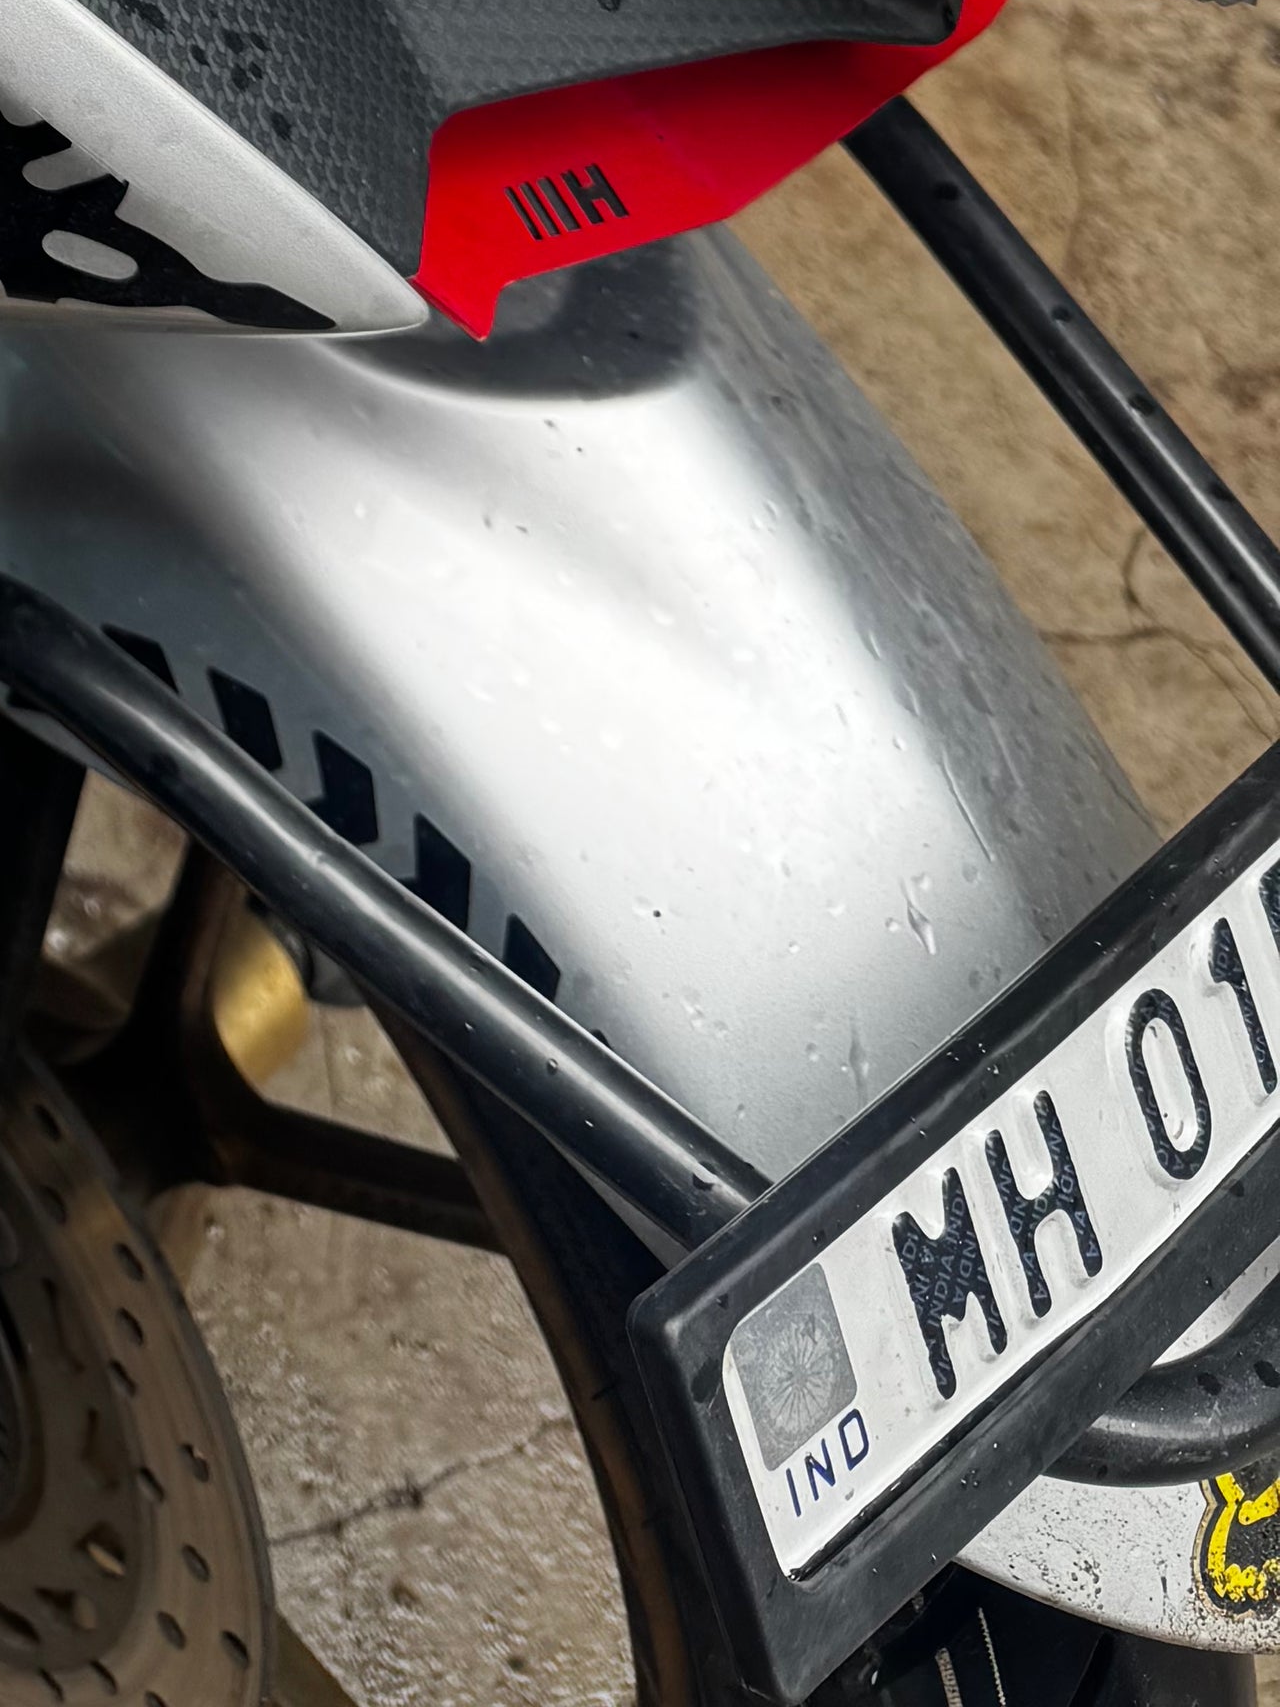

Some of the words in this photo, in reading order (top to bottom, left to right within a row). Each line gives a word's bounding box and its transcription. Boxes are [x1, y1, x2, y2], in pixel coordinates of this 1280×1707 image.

[890, 1089, 1103, 1400] MH
[1124, 915, 1278, 1182] 01
[783, 1407, 872, 1517] IND
